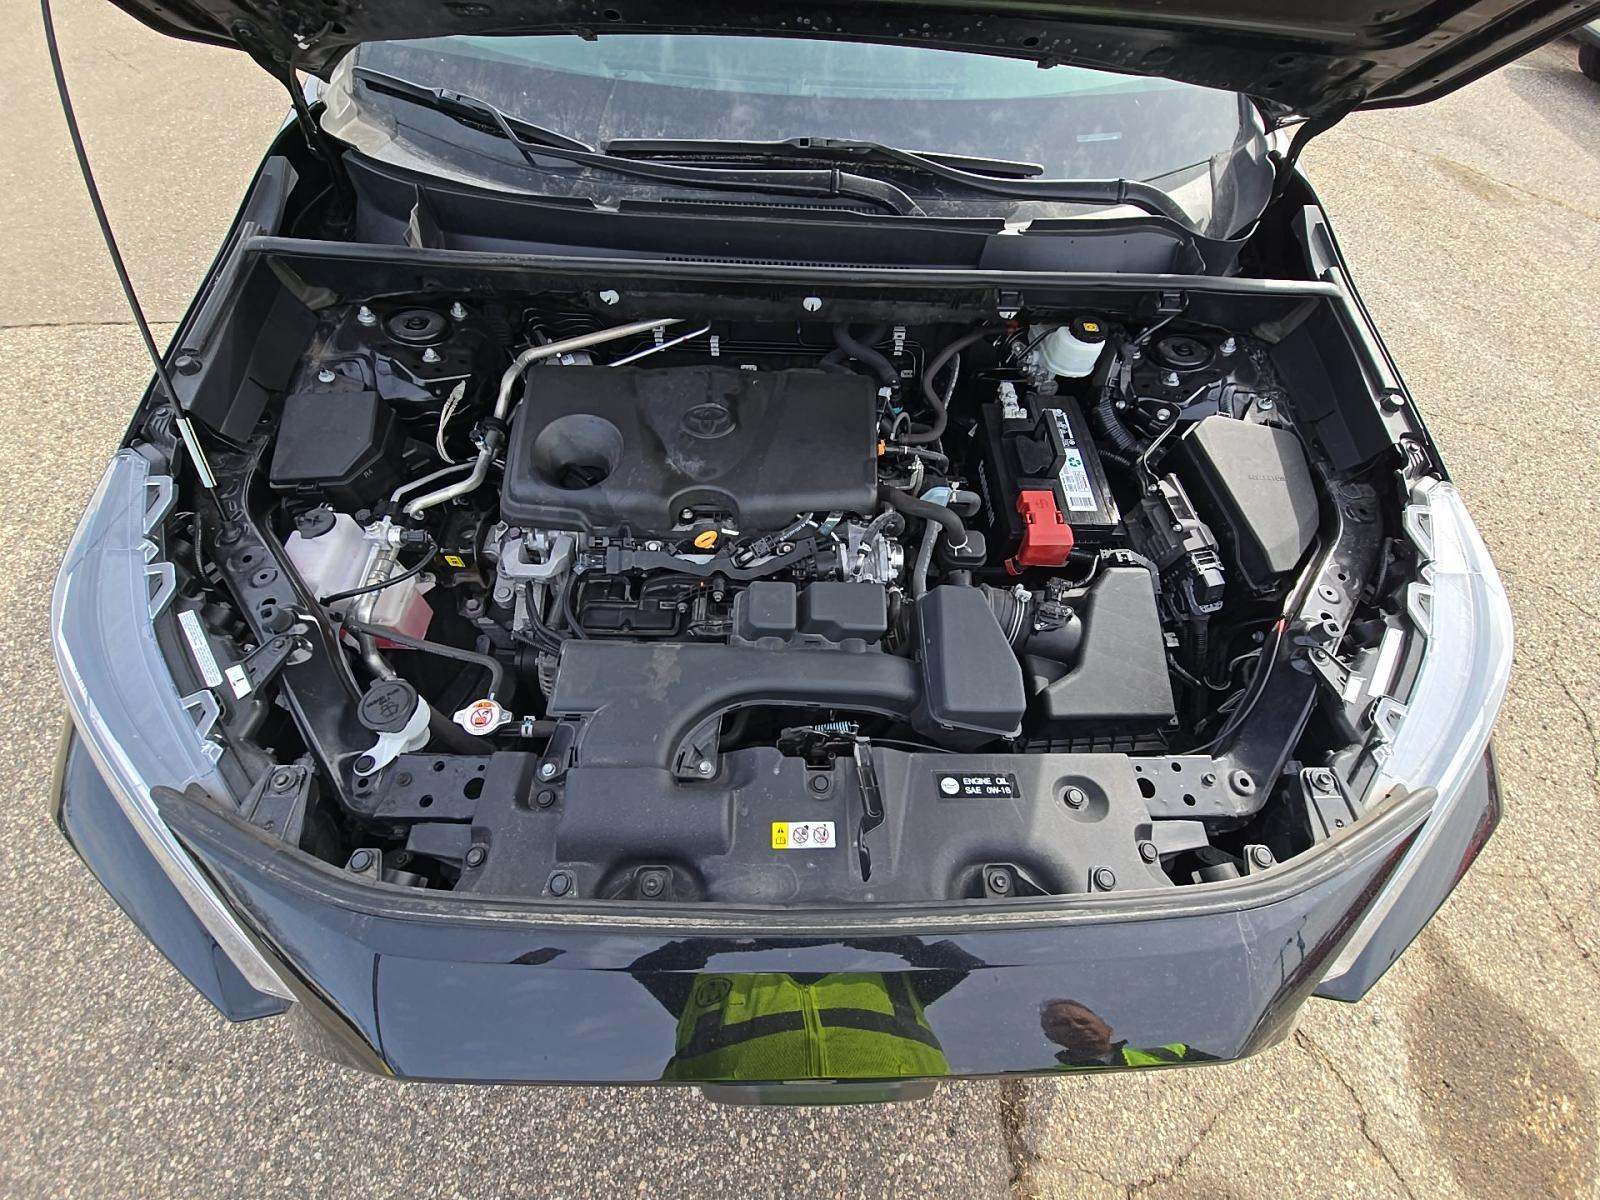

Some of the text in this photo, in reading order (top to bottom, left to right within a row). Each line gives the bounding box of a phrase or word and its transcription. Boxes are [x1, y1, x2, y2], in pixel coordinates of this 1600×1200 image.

[963, 777, 1009, 785] ENGINE OIL
[965, 786, 982, 794] SAE
